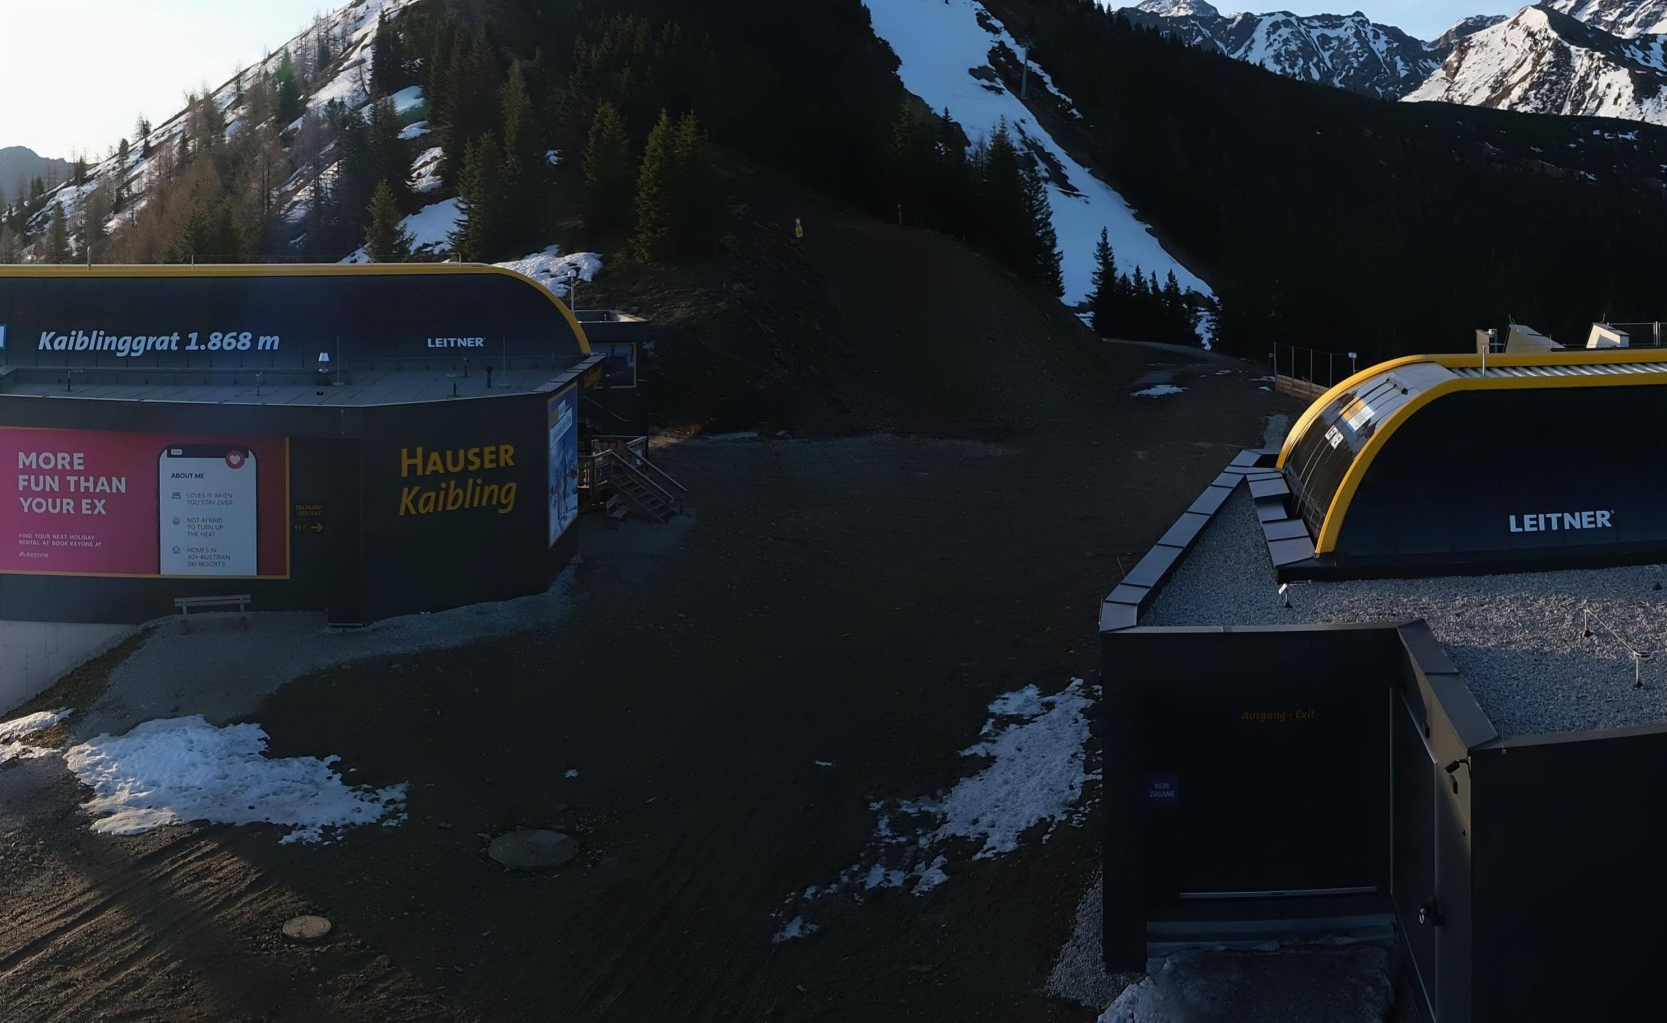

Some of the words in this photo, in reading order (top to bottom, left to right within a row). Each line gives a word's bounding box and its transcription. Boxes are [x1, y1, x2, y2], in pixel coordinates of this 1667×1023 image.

[38, 331, 180, 357] Kaiblinggrat
[185, 332, 252, 351] 1.868
[257, 335, 280, 350] m
[427, 337, 484, 348] LEITNER
[18, 451, 85, 470] MORE
[401, 445, 516, 478] HAUSER
[18, 474, 59, 492] FUN
[66, 476, 126, 493] THAN
[19, 497, 75, 514] YOUR
[81, 499, 107, 515] EX
[399, 478, 518, 516] Kaibling
[1509, 510, 1613, 533] LEITNER
[1241, 710, 1287, 722] Ausgang
[1295, 708, 1316, 719] Exit
[1149, 790, 1176, 798] ZUGANG
[1154, 782, 1171, 790] KEIN
